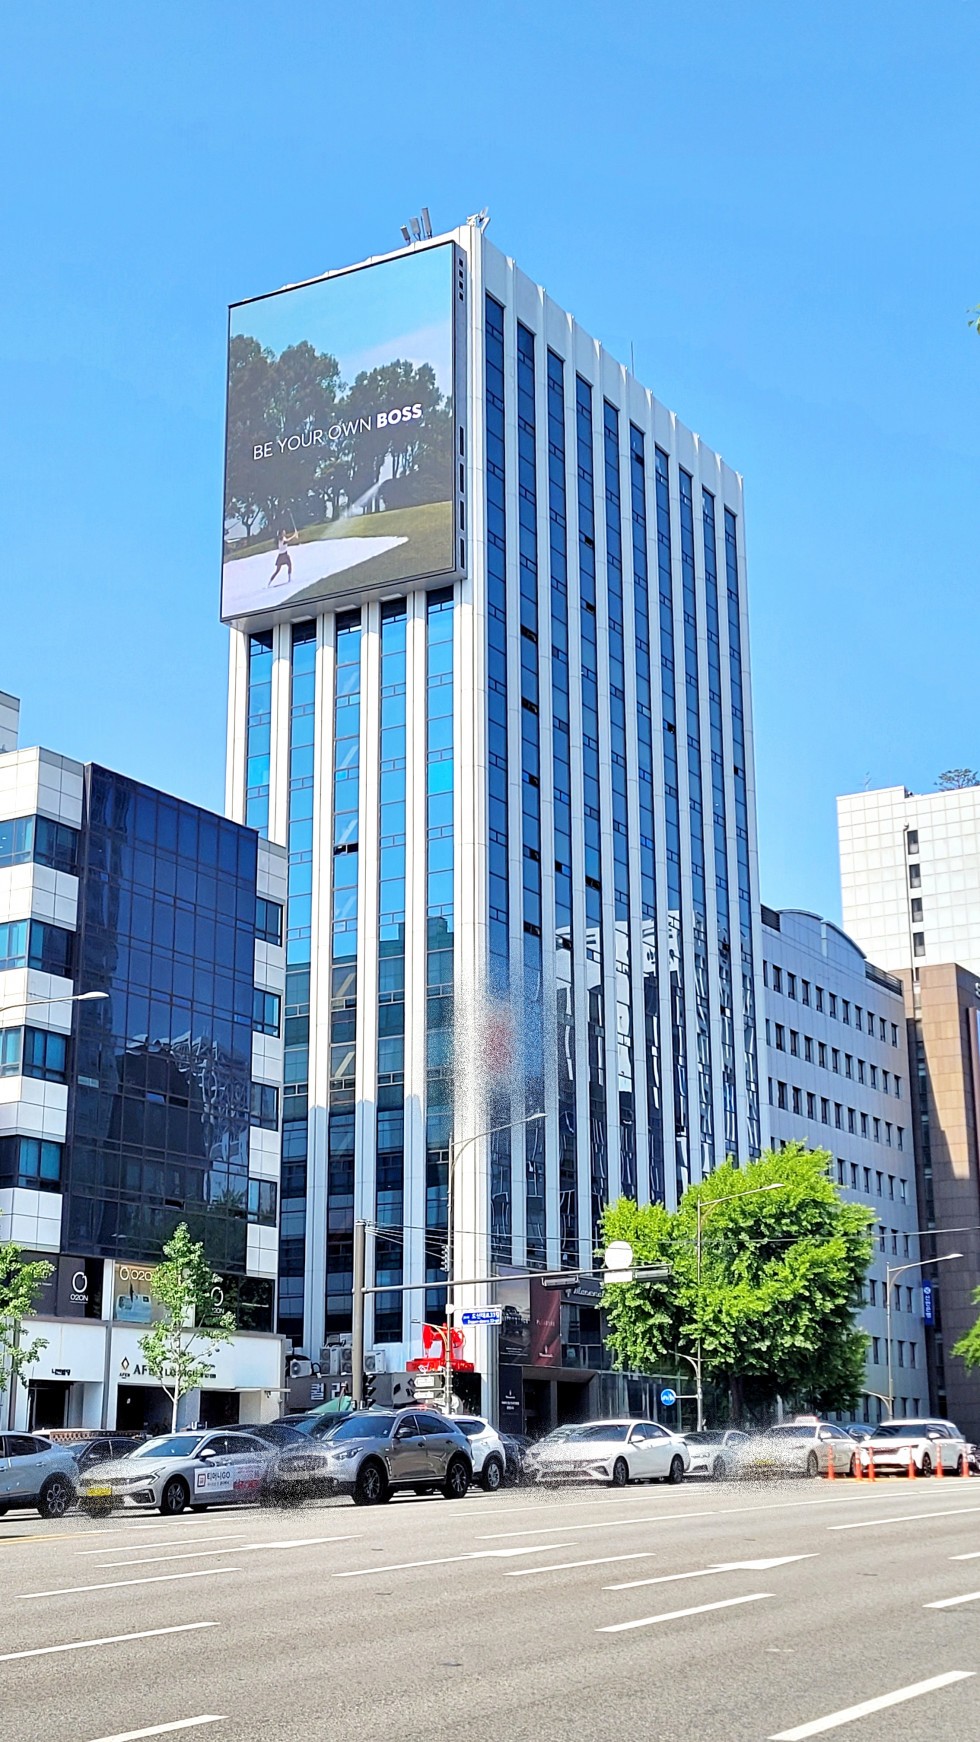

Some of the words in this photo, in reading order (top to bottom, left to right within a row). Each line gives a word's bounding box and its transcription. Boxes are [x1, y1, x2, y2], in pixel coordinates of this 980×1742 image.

[253, 442, 273, 460] BE
[277, 430, 323, 453] YOUR
[328, 416, 372, 440] OWN
[376, 403, 422, 428] BOSS
